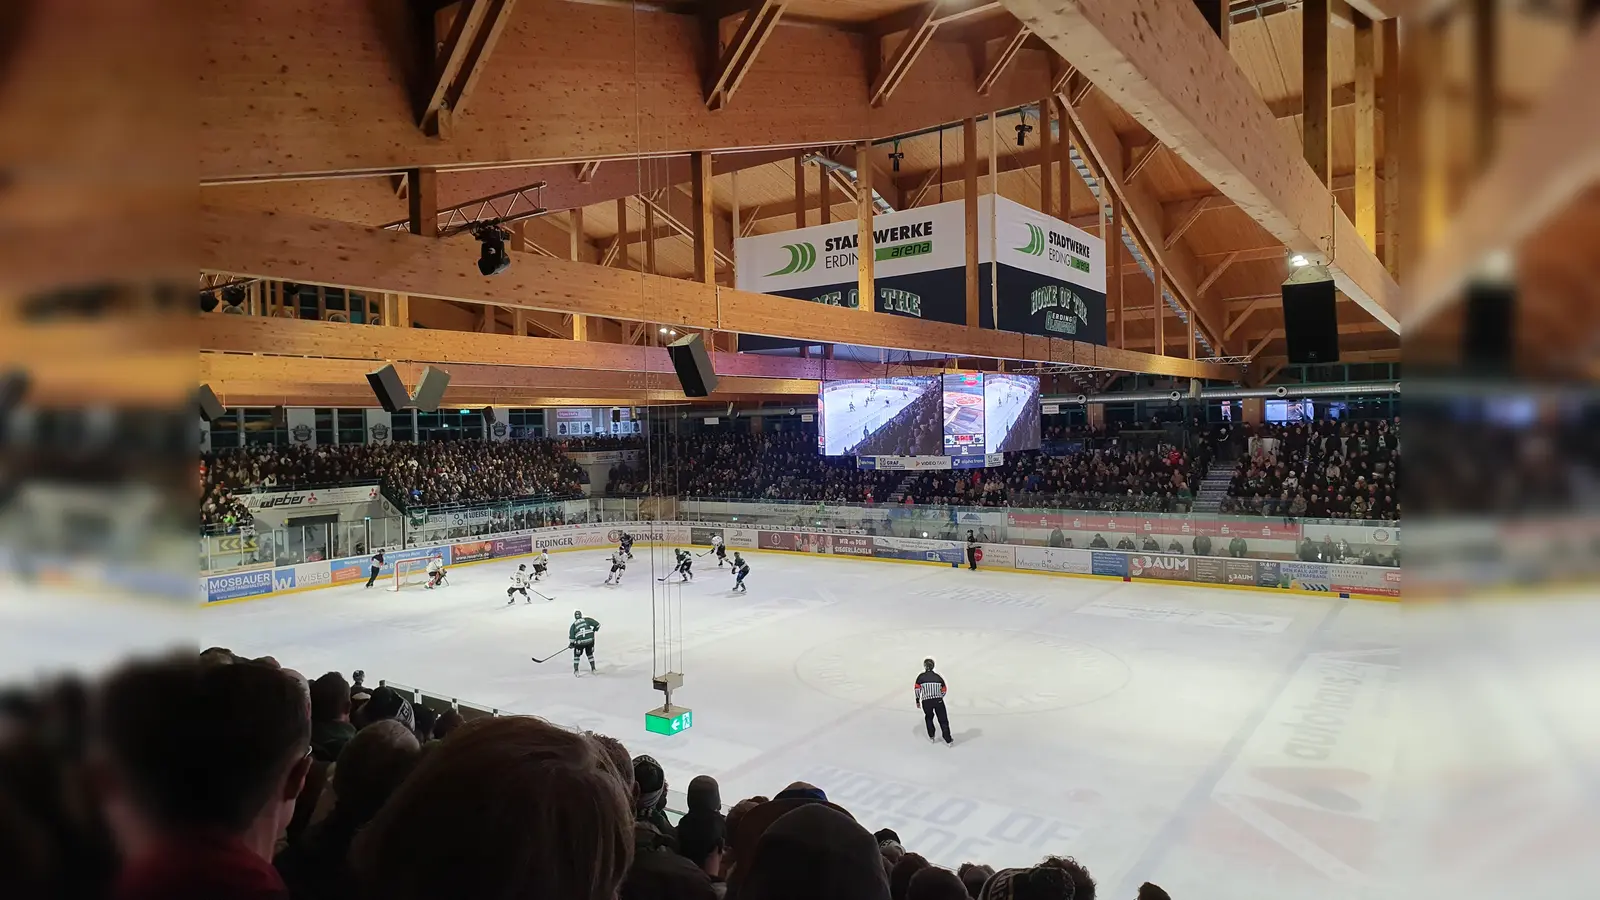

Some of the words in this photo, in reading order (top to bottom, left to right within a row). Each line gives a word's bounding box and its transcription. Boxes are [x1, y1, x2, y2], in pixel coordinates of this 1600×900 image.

[891, 242, 930, 257] arena
[1049, 230, 1090, 259] STADTWERKE
[1049, 247, 1071, 267] ERDING
[1076, 258, 1090, 273] arena
[881, 287, 921, 317] THE
[1031, 285, 1057, 316] HOME
[1060, 286, 1071, 309] OF
[1073, 292, 1088, 326] THE
[1052, 312, 1073, 323] ERDING
[260, 492, 306, 508] weber
[535, 537, 574, 549] ERDINGER
[632, 532, 664, 541] RDINGER
[1143, 555, 1189, 571] BAUM
[209, 572, 272, 590] MOSBAUER
